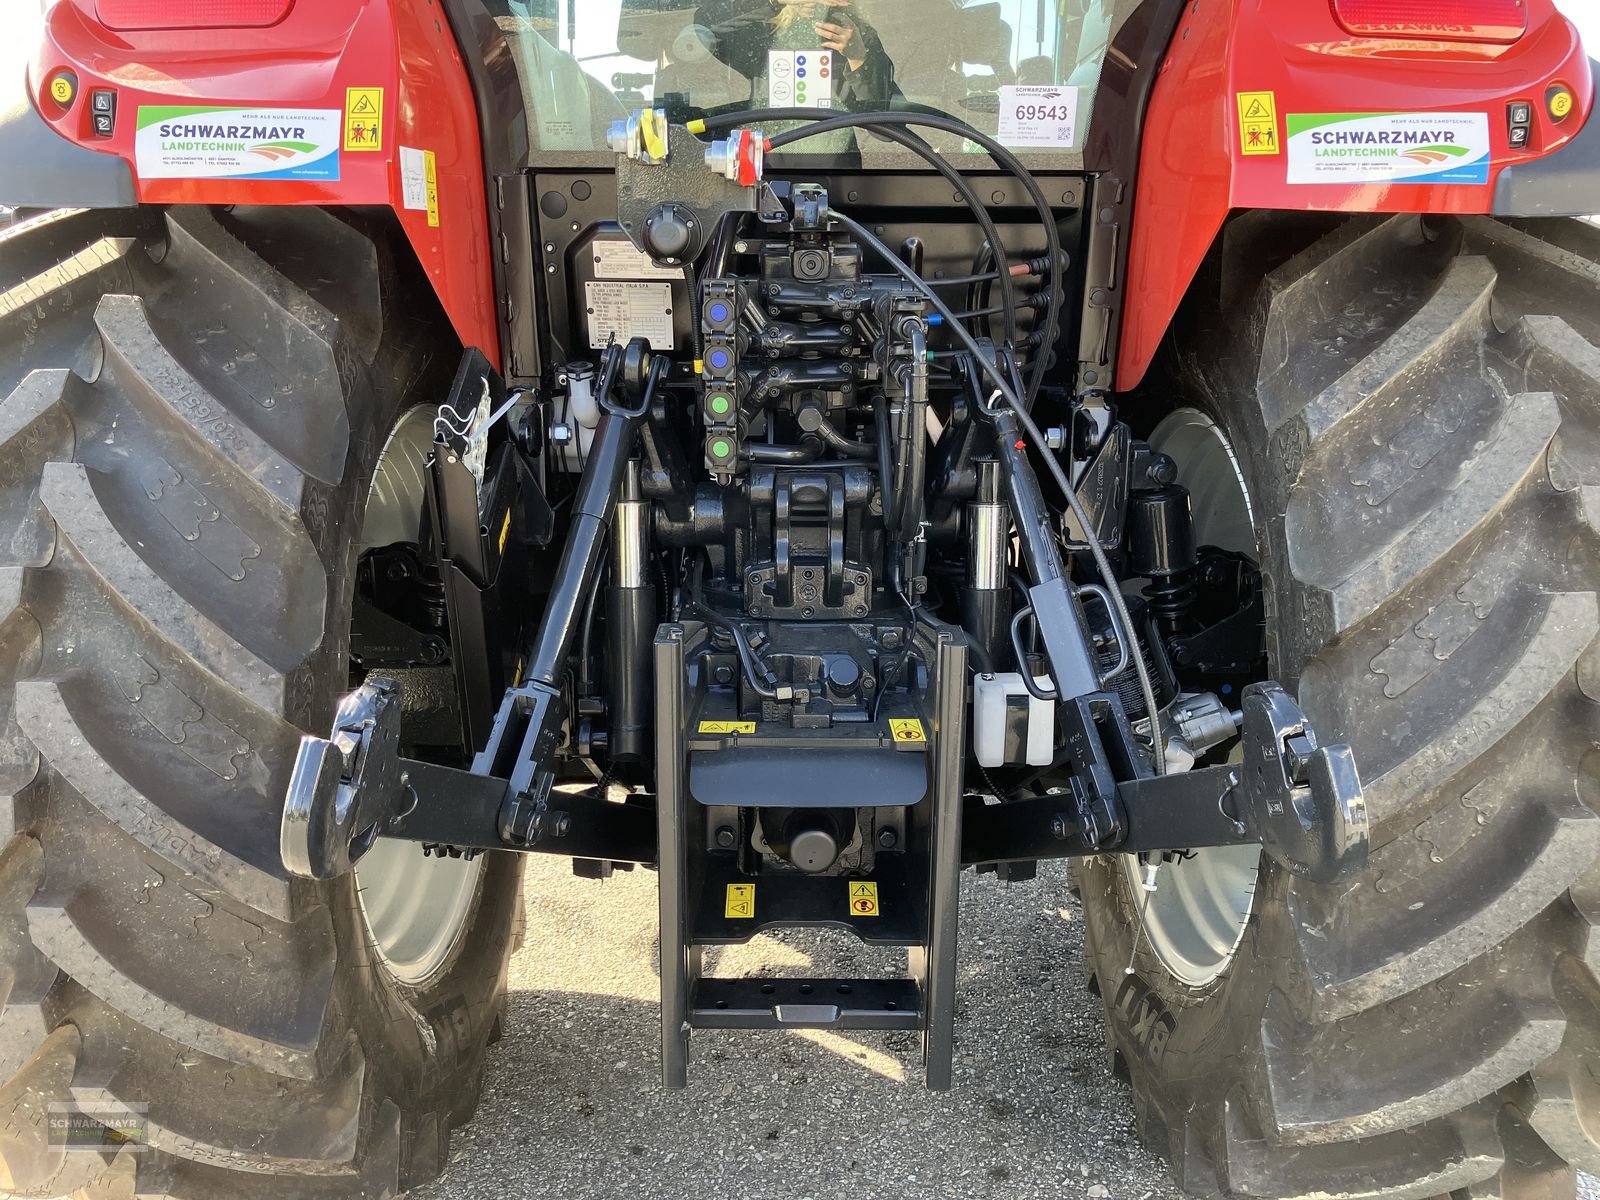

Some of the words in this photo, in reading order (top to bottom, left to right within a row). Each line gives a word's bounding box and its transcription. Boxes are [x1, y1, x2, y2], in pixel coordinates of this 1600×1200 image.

[1015, 105, 1068, 121] 69543
[159, 124, 305, 140] SCHWARZMAYR
[1311, 130, 1456, 145] SCHWARZMAYR
[161, 141, 246, 152] LANDTECHNIK
[1314, 147, 1399, 158] LANDTECHNIK
[132, 806, 221, 872] RADIAL
